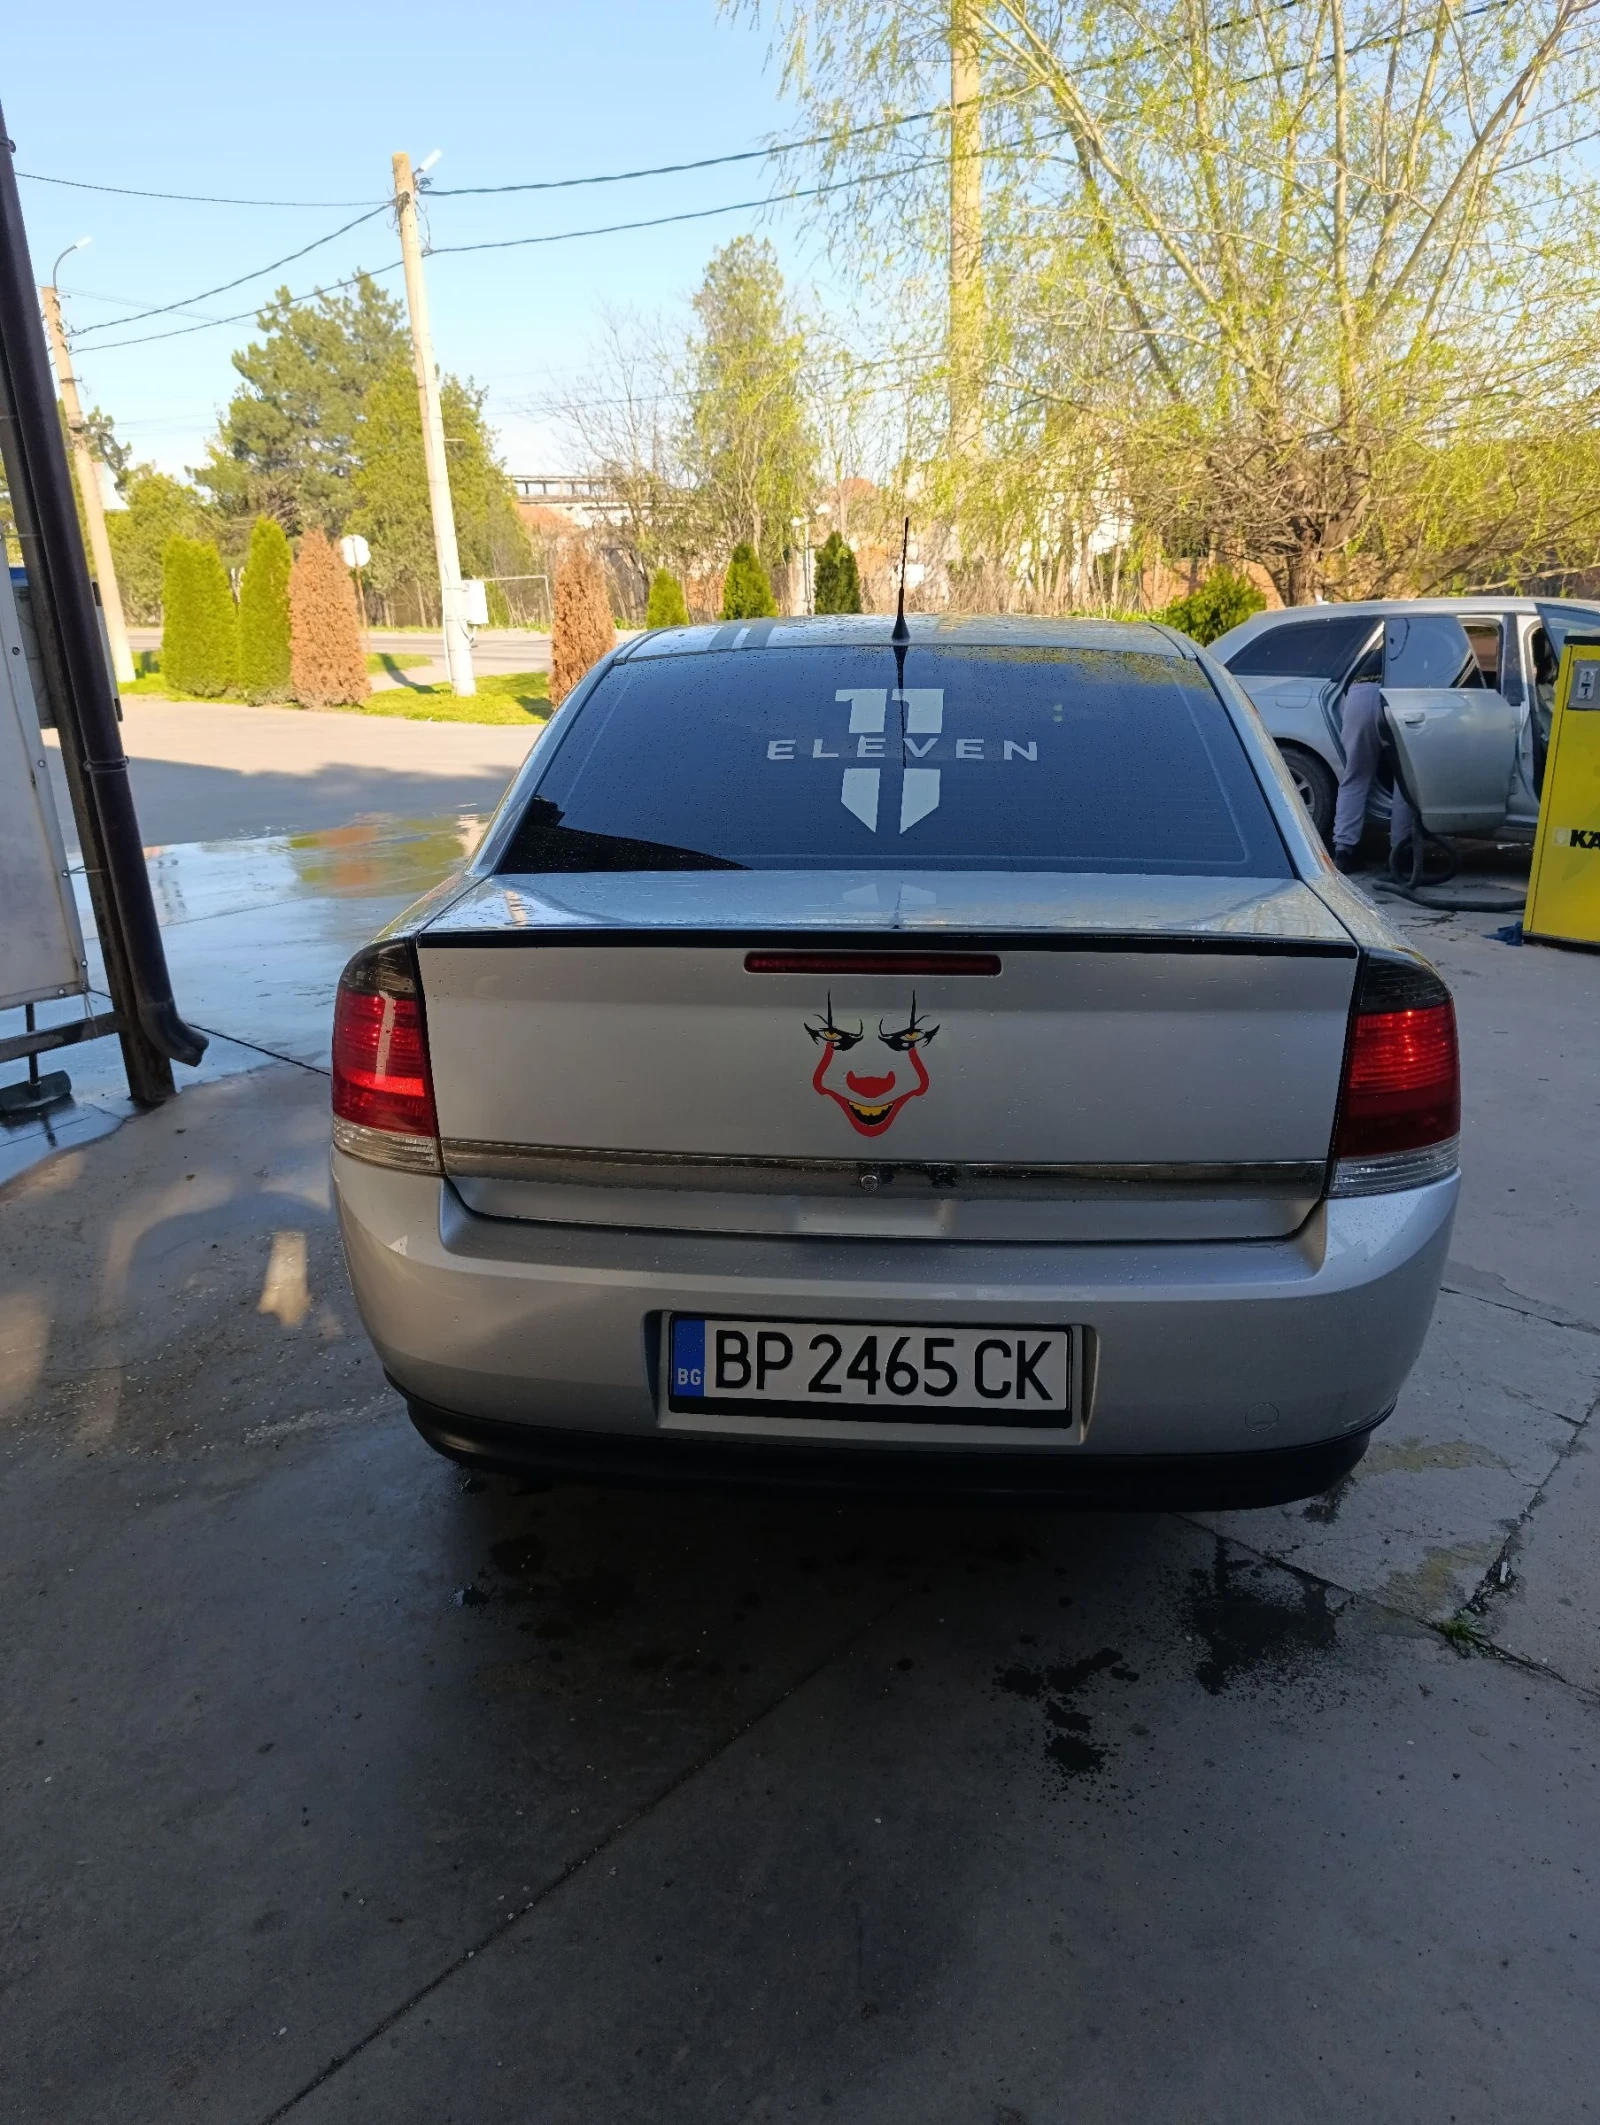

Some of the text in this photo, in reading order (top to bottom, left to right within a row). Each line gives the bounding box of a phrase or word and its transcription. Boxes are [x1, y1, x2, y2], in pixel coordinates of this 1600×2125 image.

[767, 736, 1038, 761] ELEVEN
[677, 1367, 701, 1386] BG
[715, 1329, 1054, 1401] BP 2465 CK
